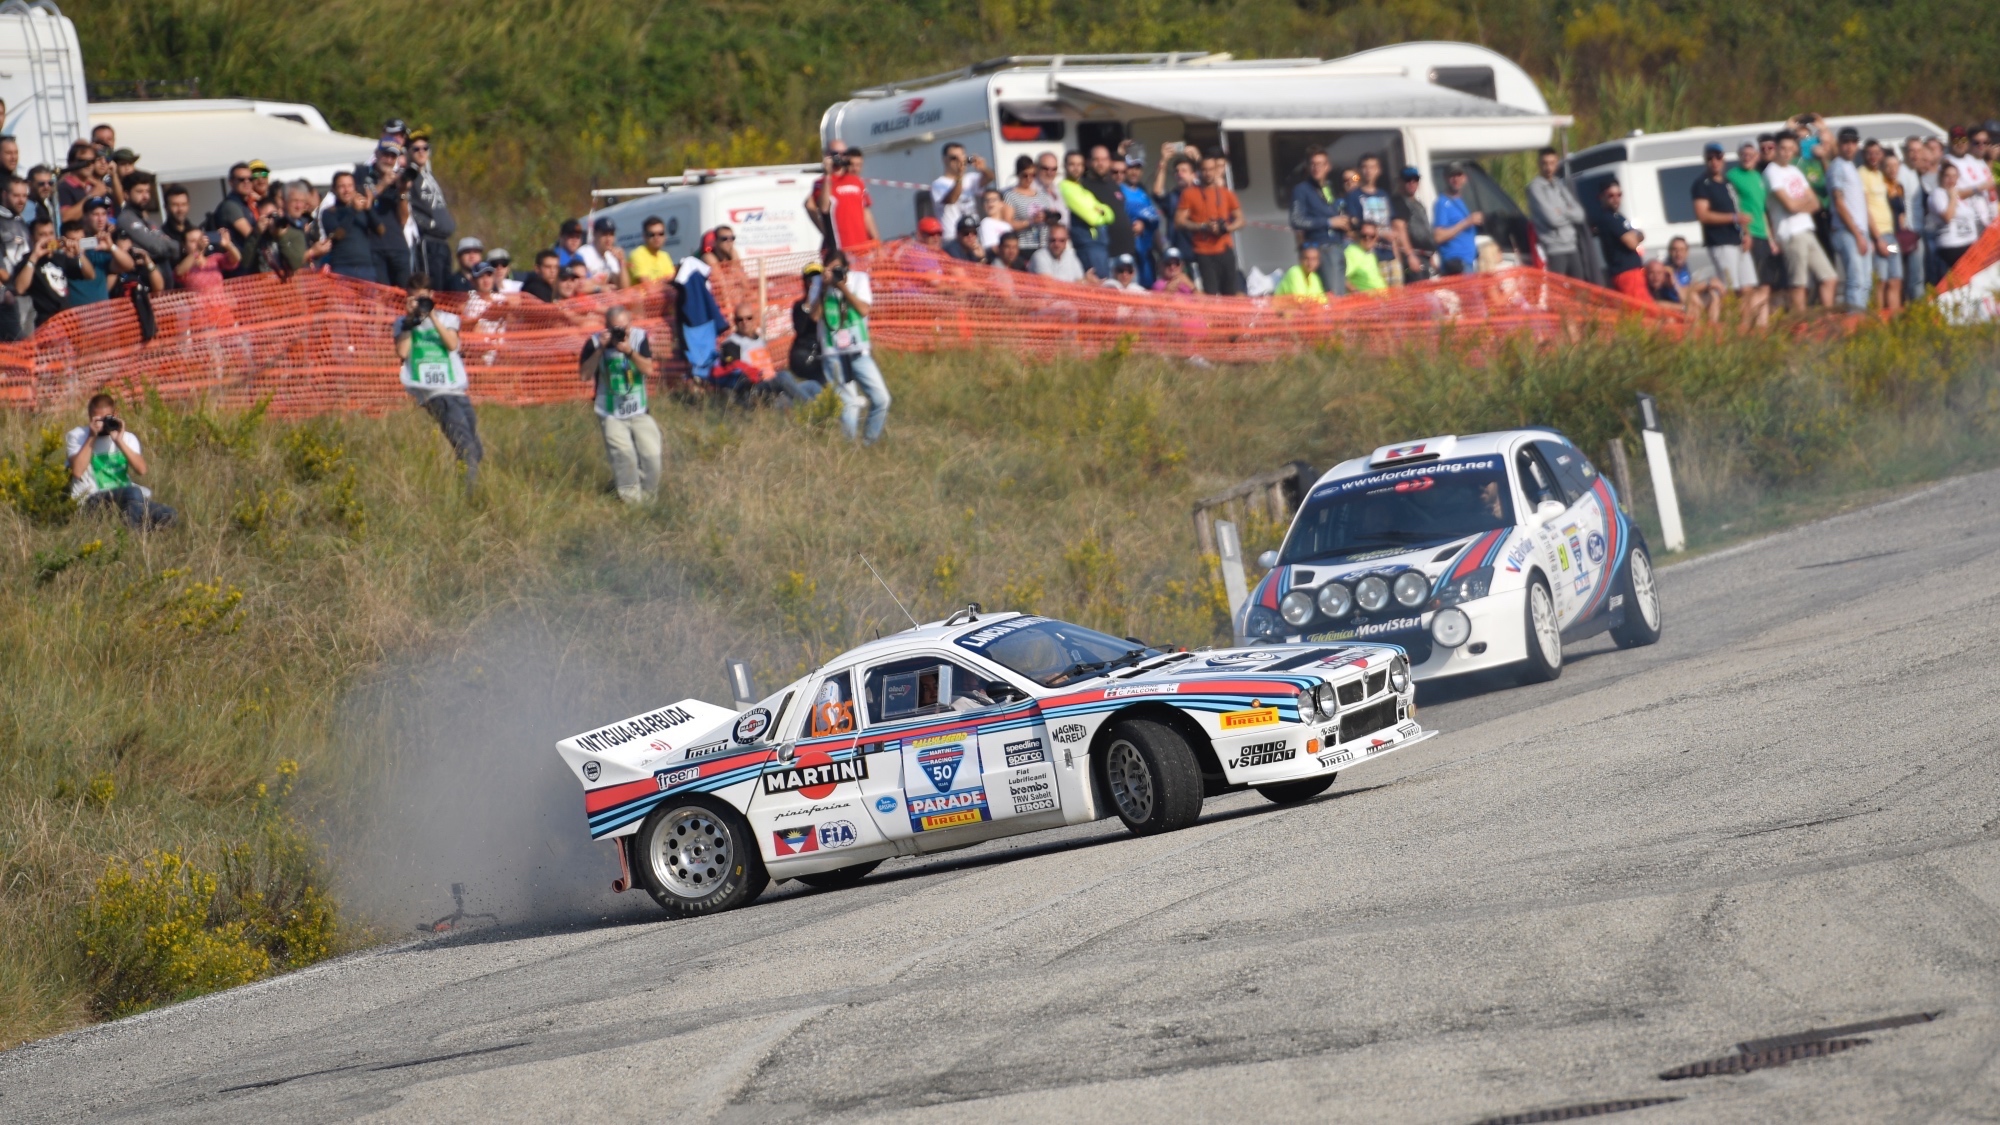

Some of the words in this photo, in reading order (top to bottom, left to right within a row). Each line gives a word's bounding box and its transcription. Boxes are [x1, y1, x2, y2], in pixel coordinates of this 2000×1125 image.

[871, 118, 911, 135] ROLLER
[914, 108, 943, 126] TEAM
[424, 371, 446, 384] 503
[1341, 460, 1493, 490] www.fordracing.net
[1355, 616, 1421, 638] MoviStar
[961, 625, 1015, 648] LANCIA
[1126, 687, 1159, 695] FALCONE
[740, 720, 765, 733] MARTINI
[811, 701, 854, 738] LS25
[1225, 711, 1273, 726] PIRELLI
[1053, 731, 1087, 744] MARELLI
[1397, 723, 1420, 739] PIRELLI
[913, 732, 968, 748] RALLYLEGEND
[1006, 740, 1041, 753] speedline
[1242, 741, 1285, 755] OLIO
[685, 739, 729, 759] PIRELLI
[929, 748, 952, 756] MARTINI
[930, 756, 953, 765] RACING
[1008, 752, 1043, 766] sparco
[1317, 749, 1355, 768] PIRELLI
[657, 767, 700, 790] freem
[767, 759, 864, 792] MARTINI
[933, 764, 952, 781] 50
[1008, 773, 1047, 785] Lubrificanti
[1016, 768, 1030, 776] Fiat
[1010, 782, 1049, 795] brembo
[912, 790, 982, 814] PARADE
[1012, 794, 1029, 804] TRW
[1030, 791, 1052, 801] Sabelt
[774, 801, 852, 822] pininfarina
[1015, 801, 1053, 812] FERODO
[925, 809, 975, 826] PIRELLI
[681, 881, 736, 911] PIRELLI
